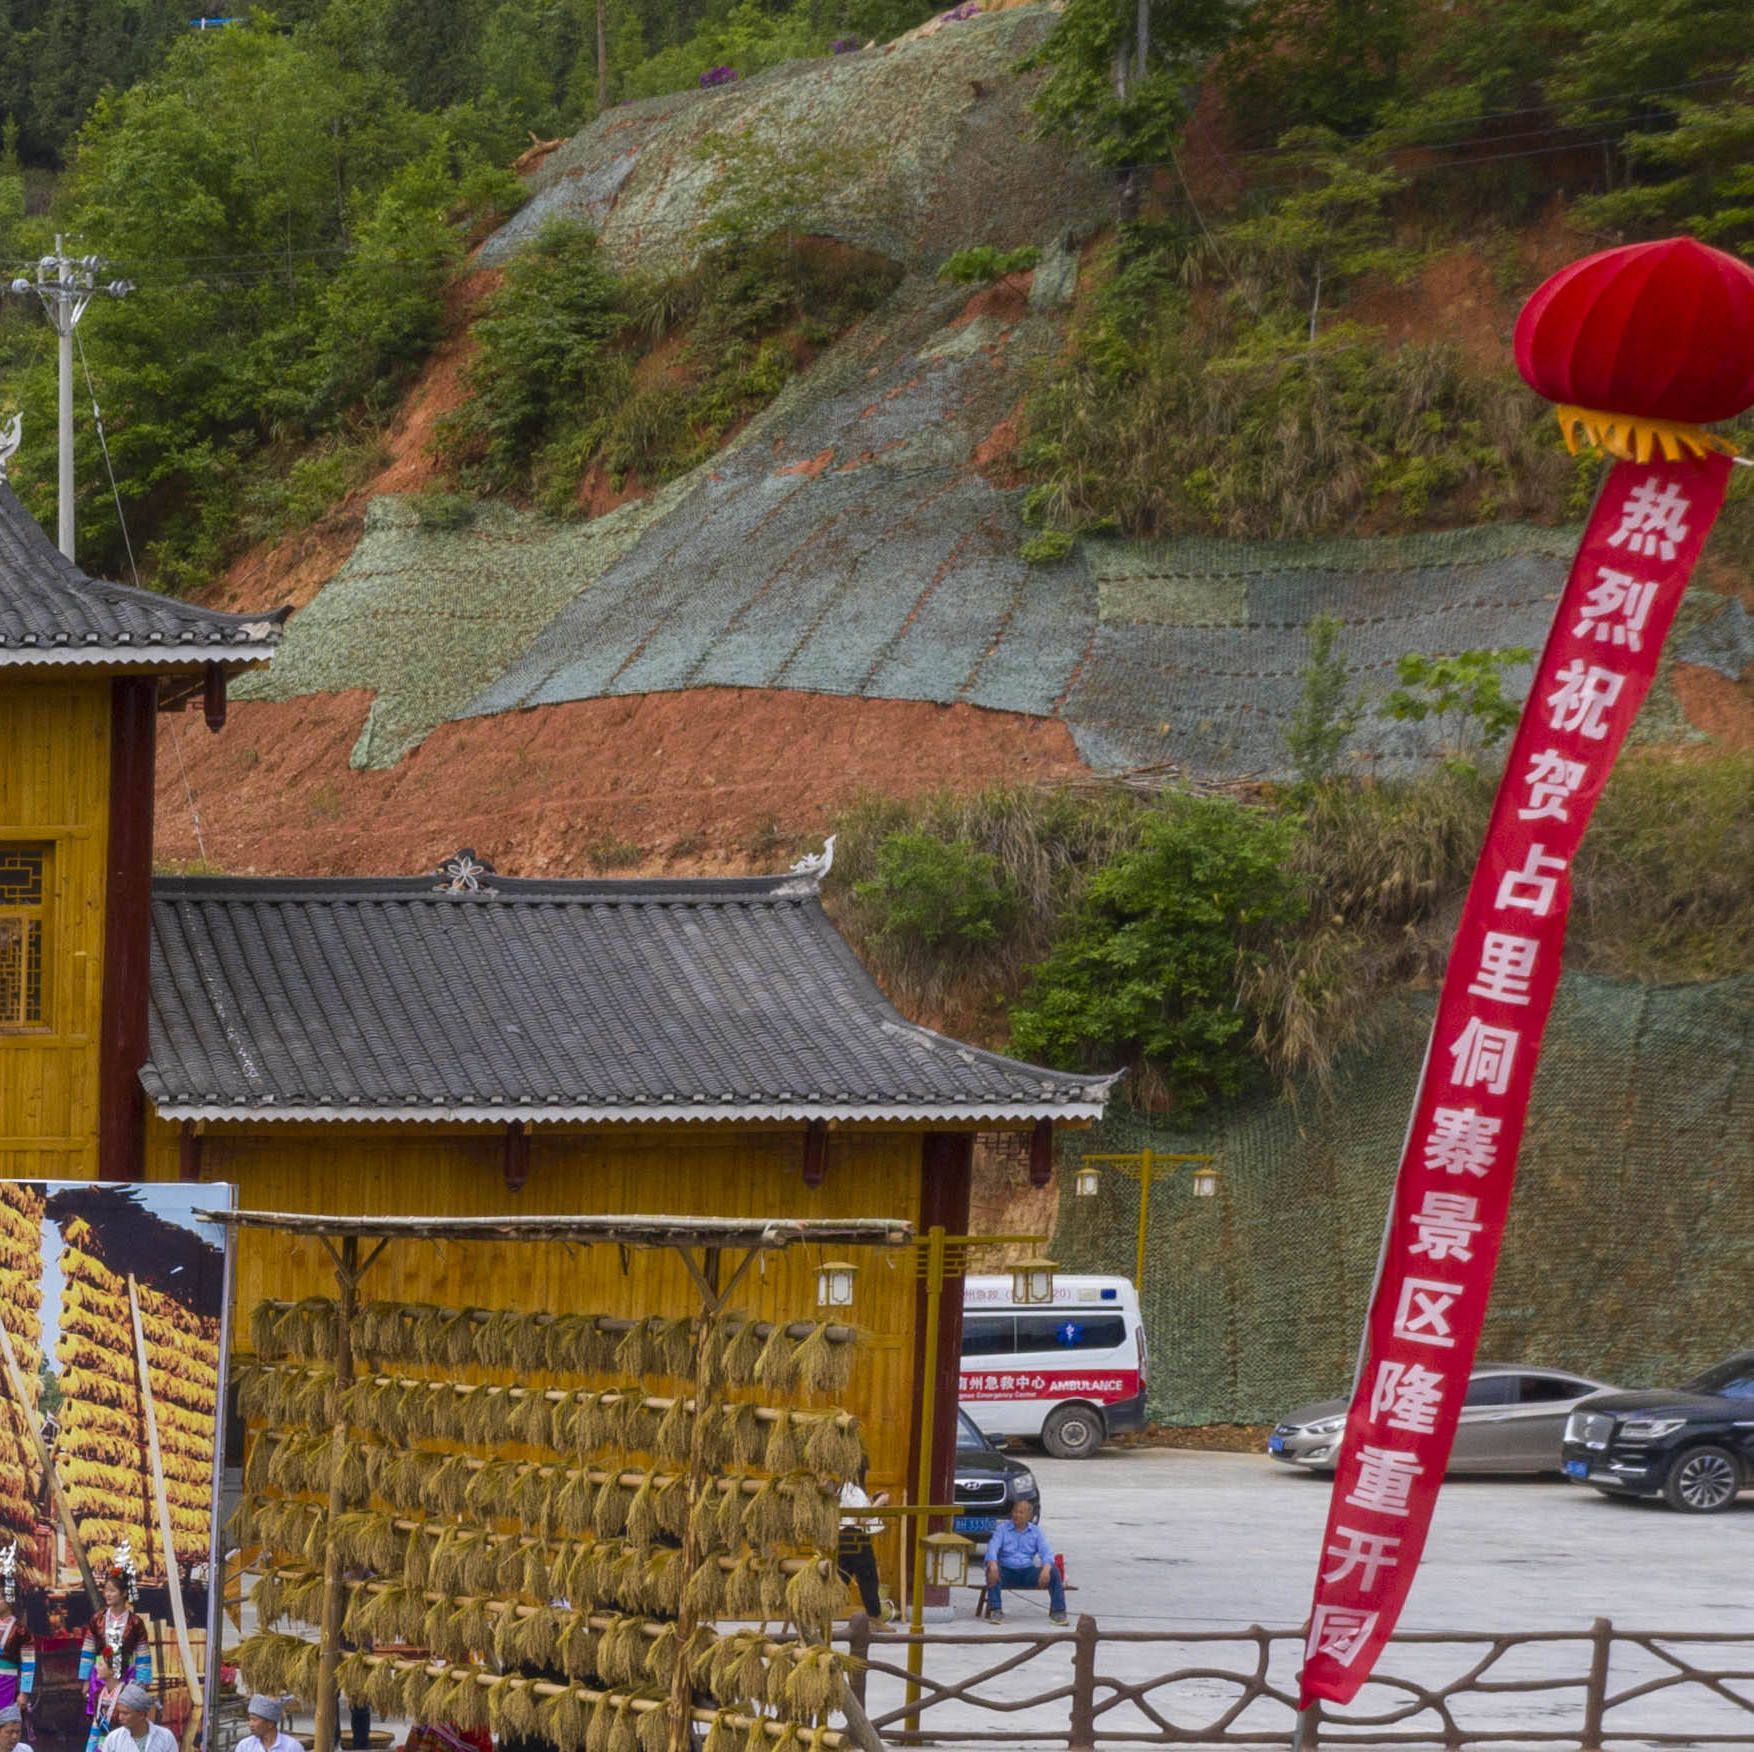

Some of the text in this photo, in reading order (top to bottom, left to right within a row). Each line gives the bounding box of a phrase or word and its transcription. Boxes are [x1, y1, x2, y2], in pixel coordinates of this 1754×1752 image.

[1306, 477, 1691, 1668] 热烈祝贺占里侗寨景区隆重开园
[1049, 1380, 1123, 1392] AMBULANCE
